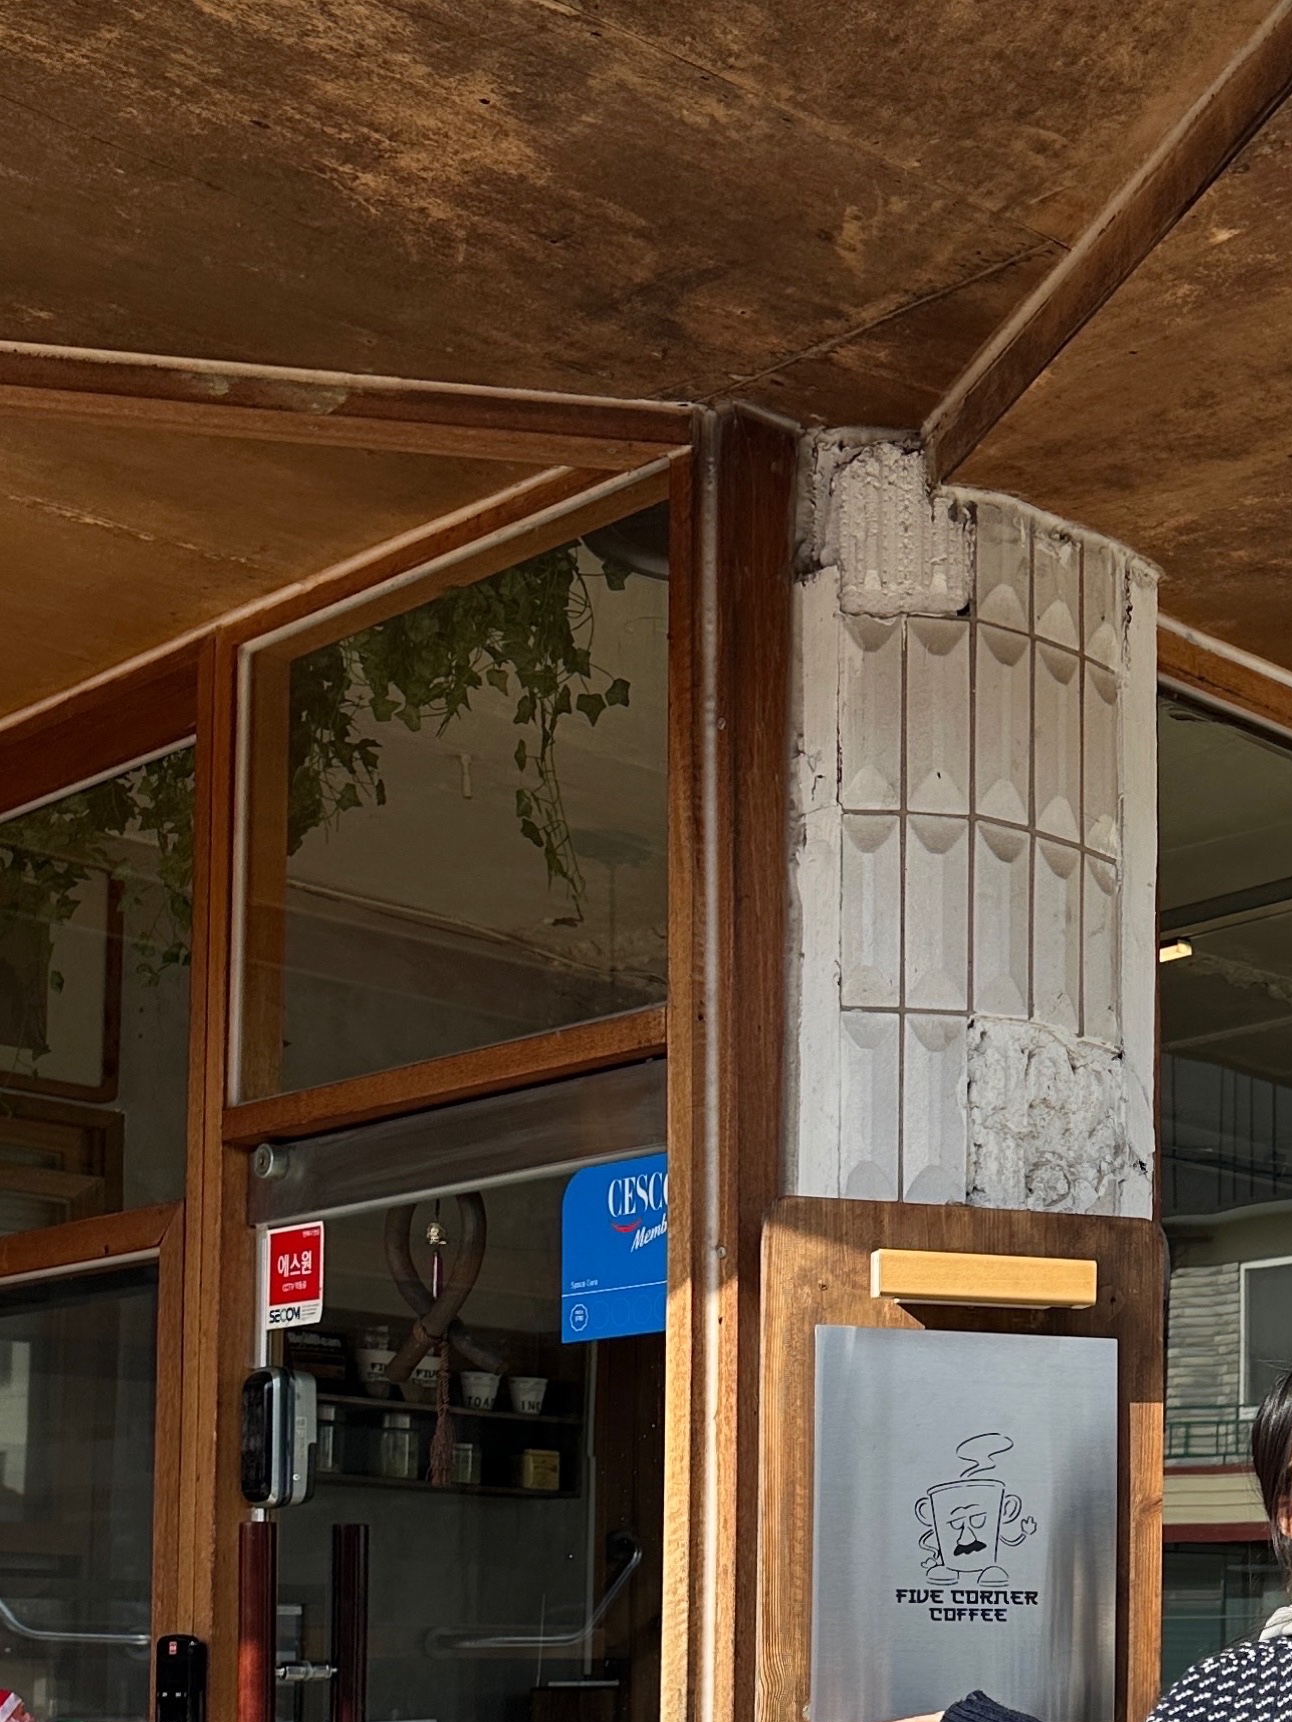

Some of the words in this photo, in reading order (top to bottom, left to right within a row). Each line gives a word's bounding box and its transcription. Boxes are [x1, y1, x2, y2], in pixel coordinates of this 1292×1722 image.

[630, 1213, 667, 1253] Memb
[277, 1250, 312, 1278] 에스원
[268, 1306, 301, 1324] SECOM
[895, 1588, 944, 1605] FIVE
[950, 1589, 1038, 1606] CORNER
[929, 1607, 1007, 1622] COFFEE
